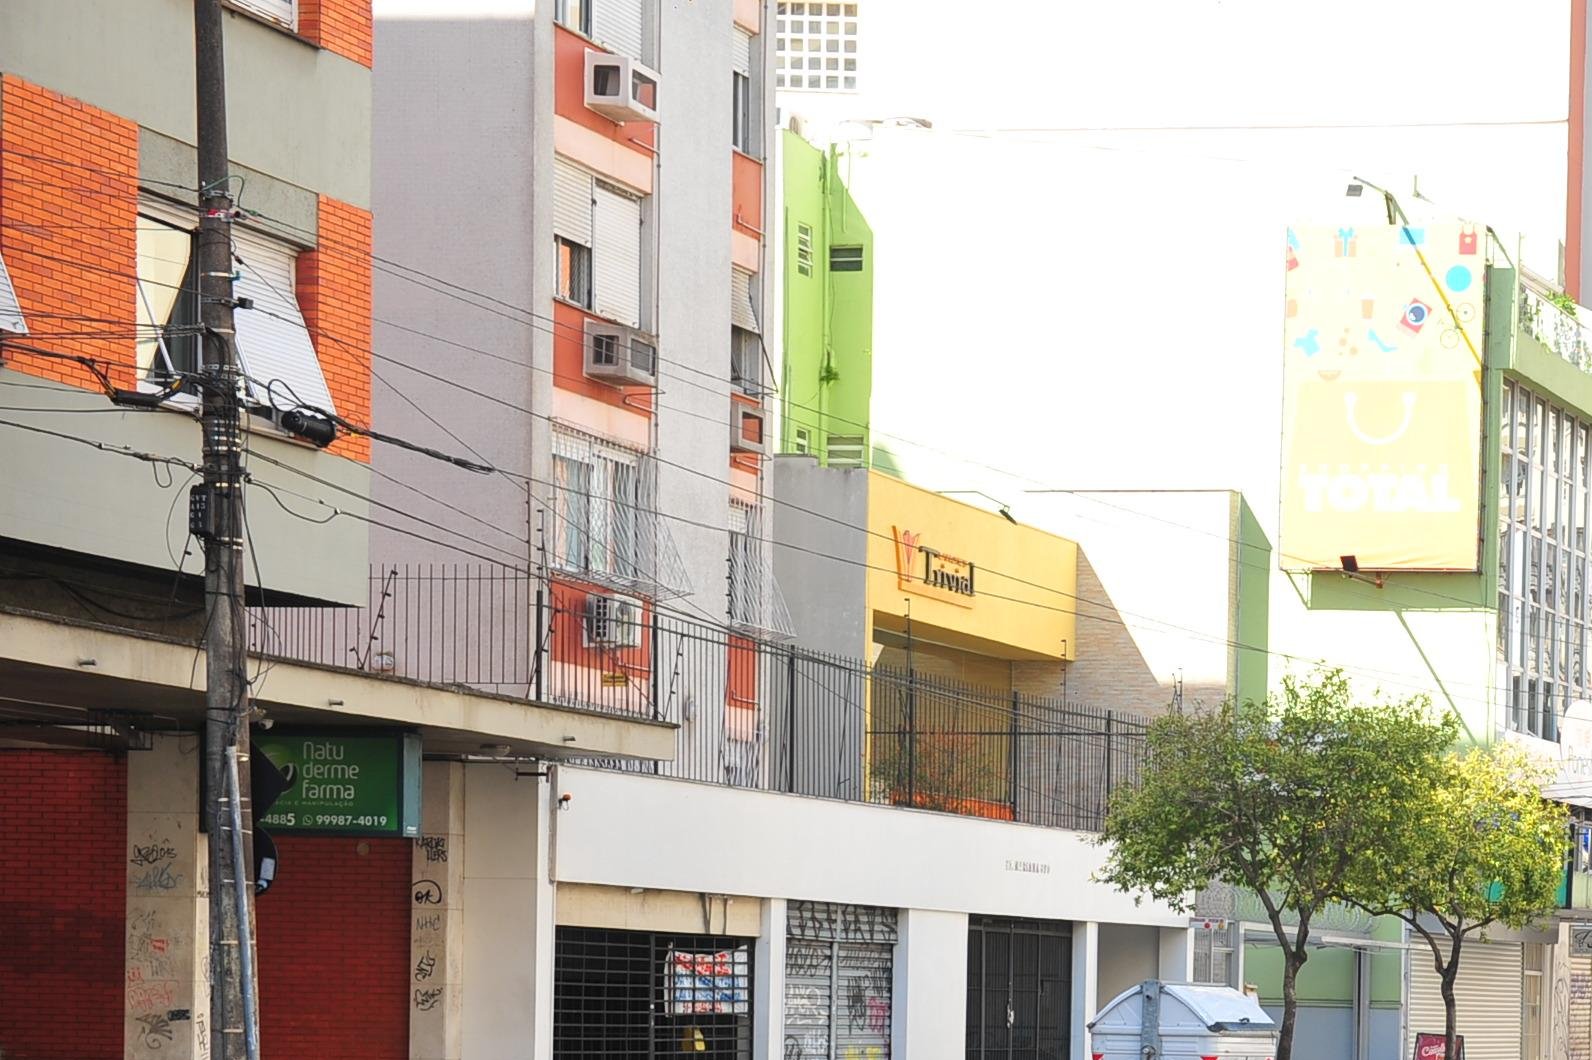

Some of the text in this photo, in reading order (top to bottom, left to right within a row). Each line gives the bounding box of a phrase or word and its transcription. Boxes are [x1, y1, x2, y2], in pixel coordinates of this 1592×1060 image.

[1298, 473, 1462, 513] TOTAL
[303, 761, 360, 780] derme
[302, 780, 355, 799] farma
[316, 815, 387, 826] 99987-4019
